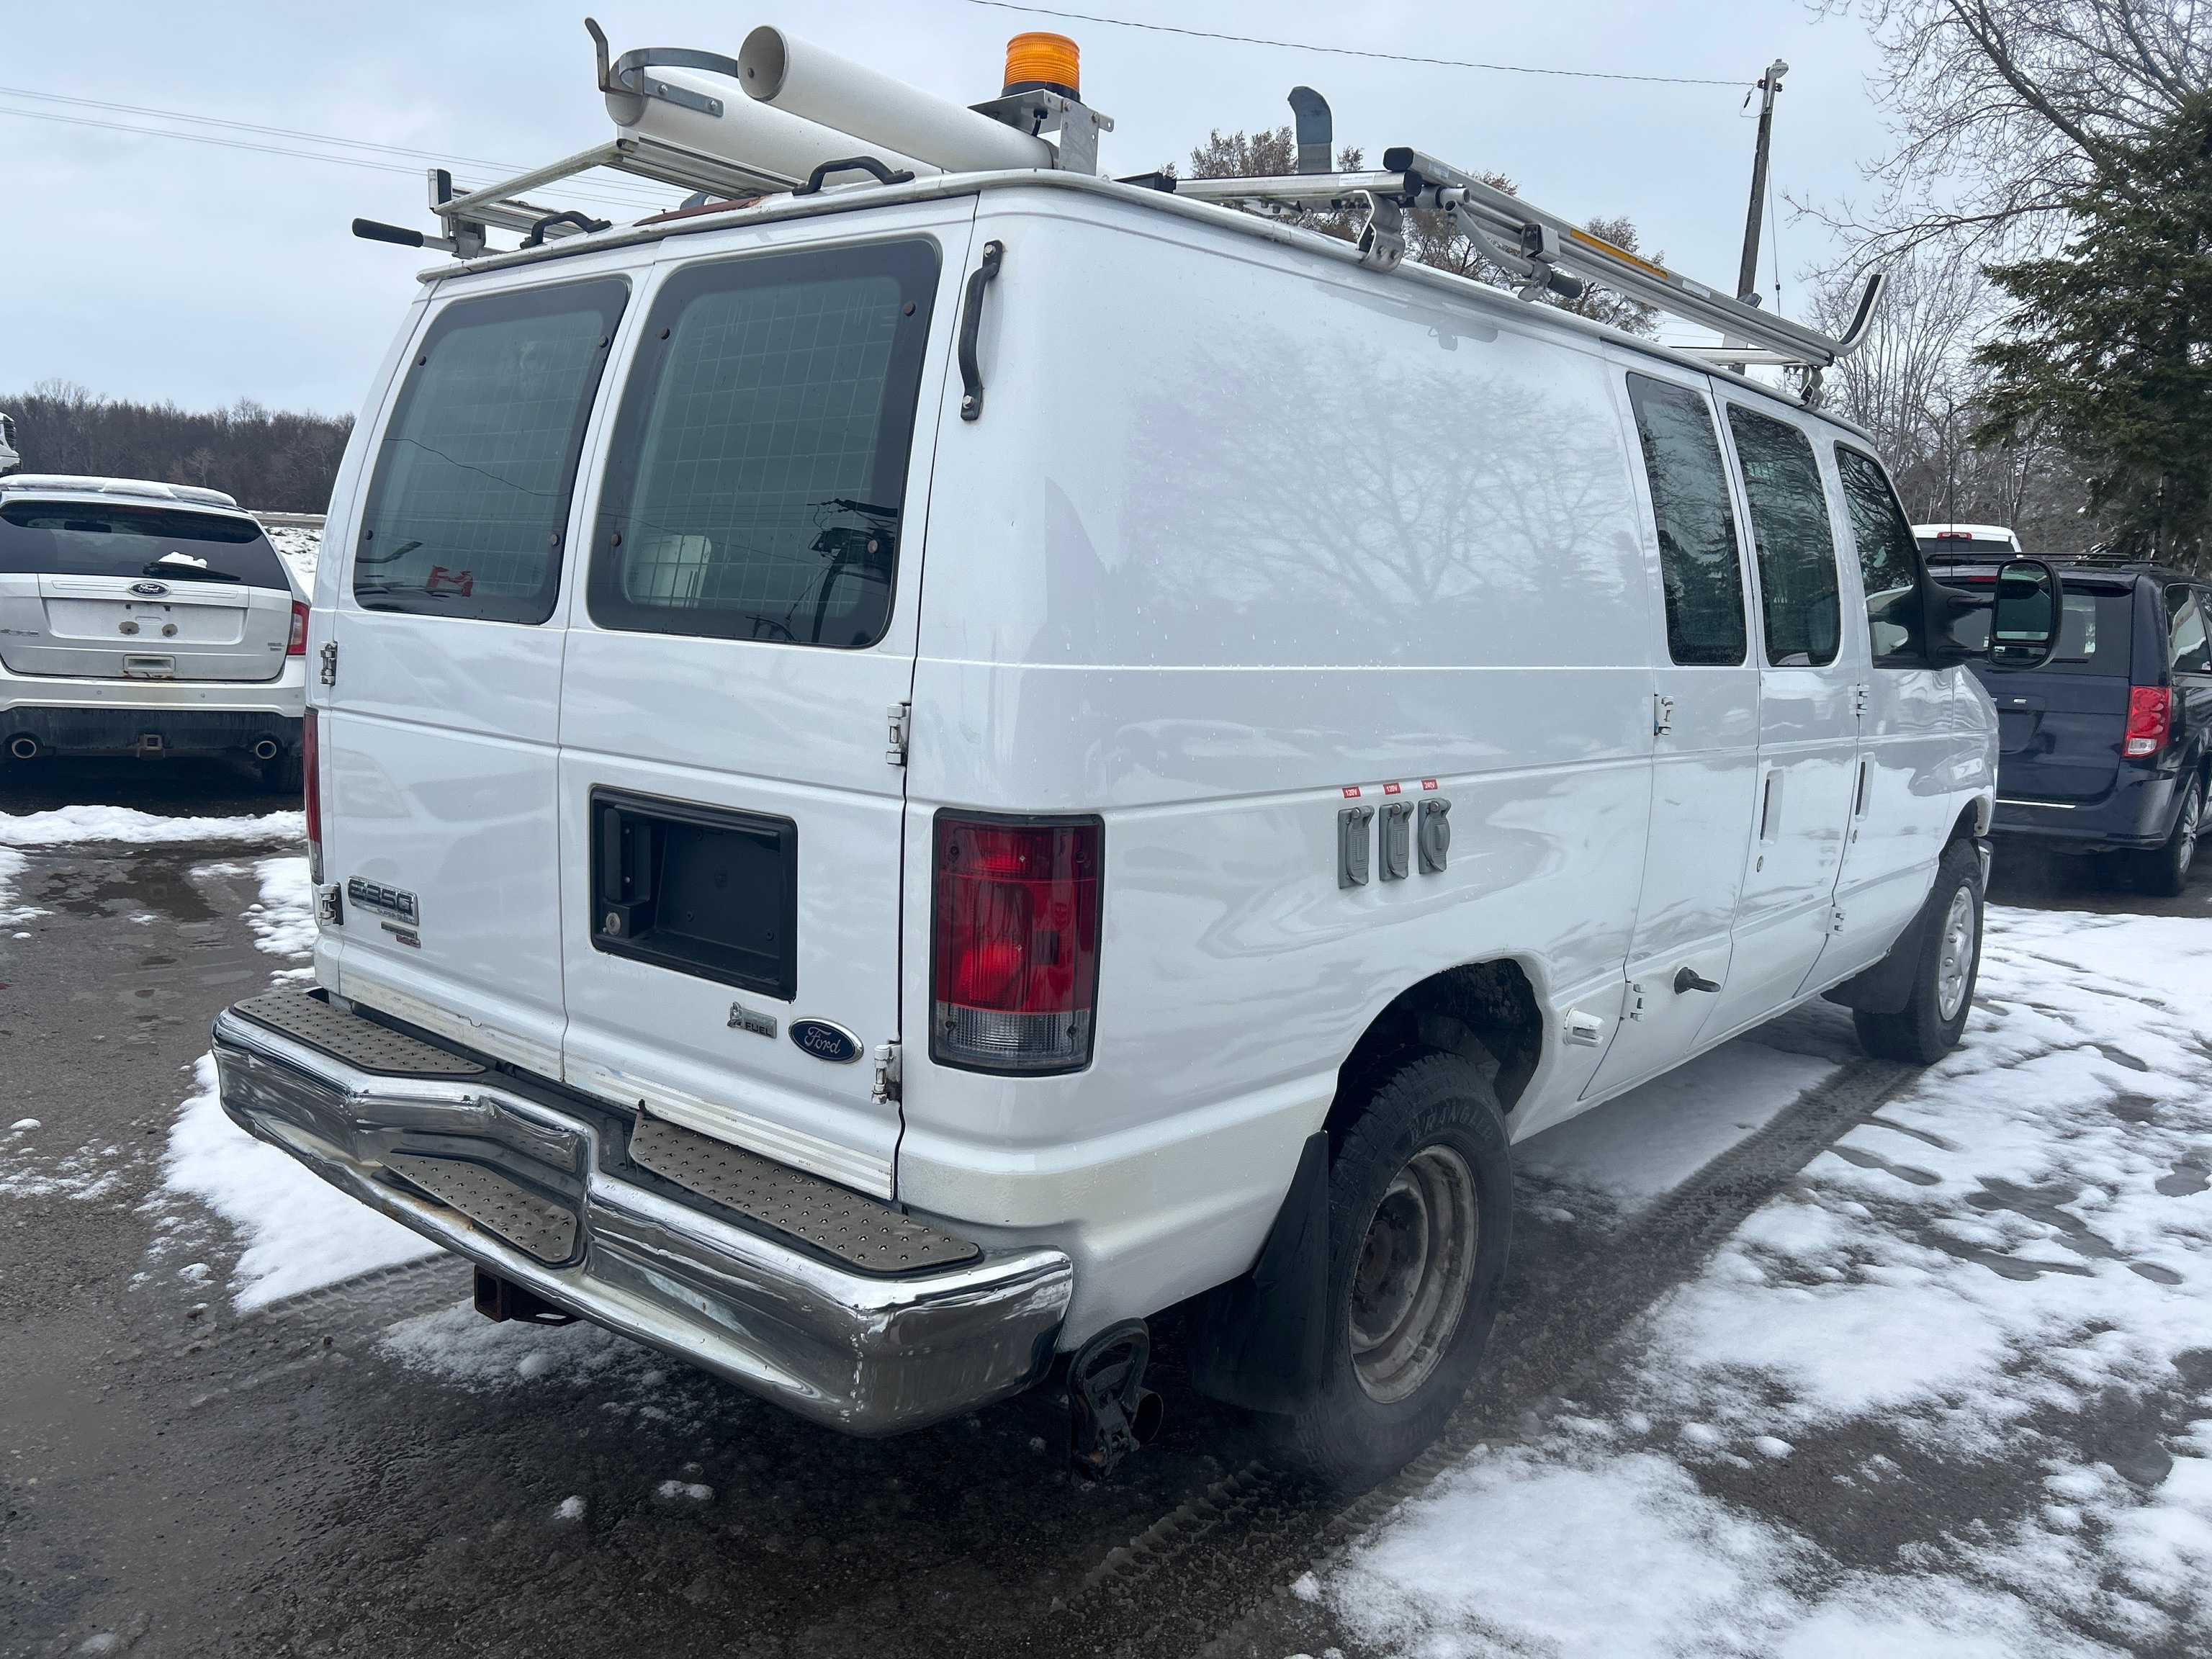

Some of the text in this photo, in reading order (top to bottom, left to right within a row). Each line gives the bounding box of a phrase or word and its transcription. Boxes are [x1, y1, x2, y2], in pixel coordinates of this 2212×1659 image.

[138, 584, 160, 593] Ford
[745, 1020, 773, 1037] FUEL
[804, 1026, 841, 1054] Ford
[1404, 1097, 1494, 1146] WRANGLER
